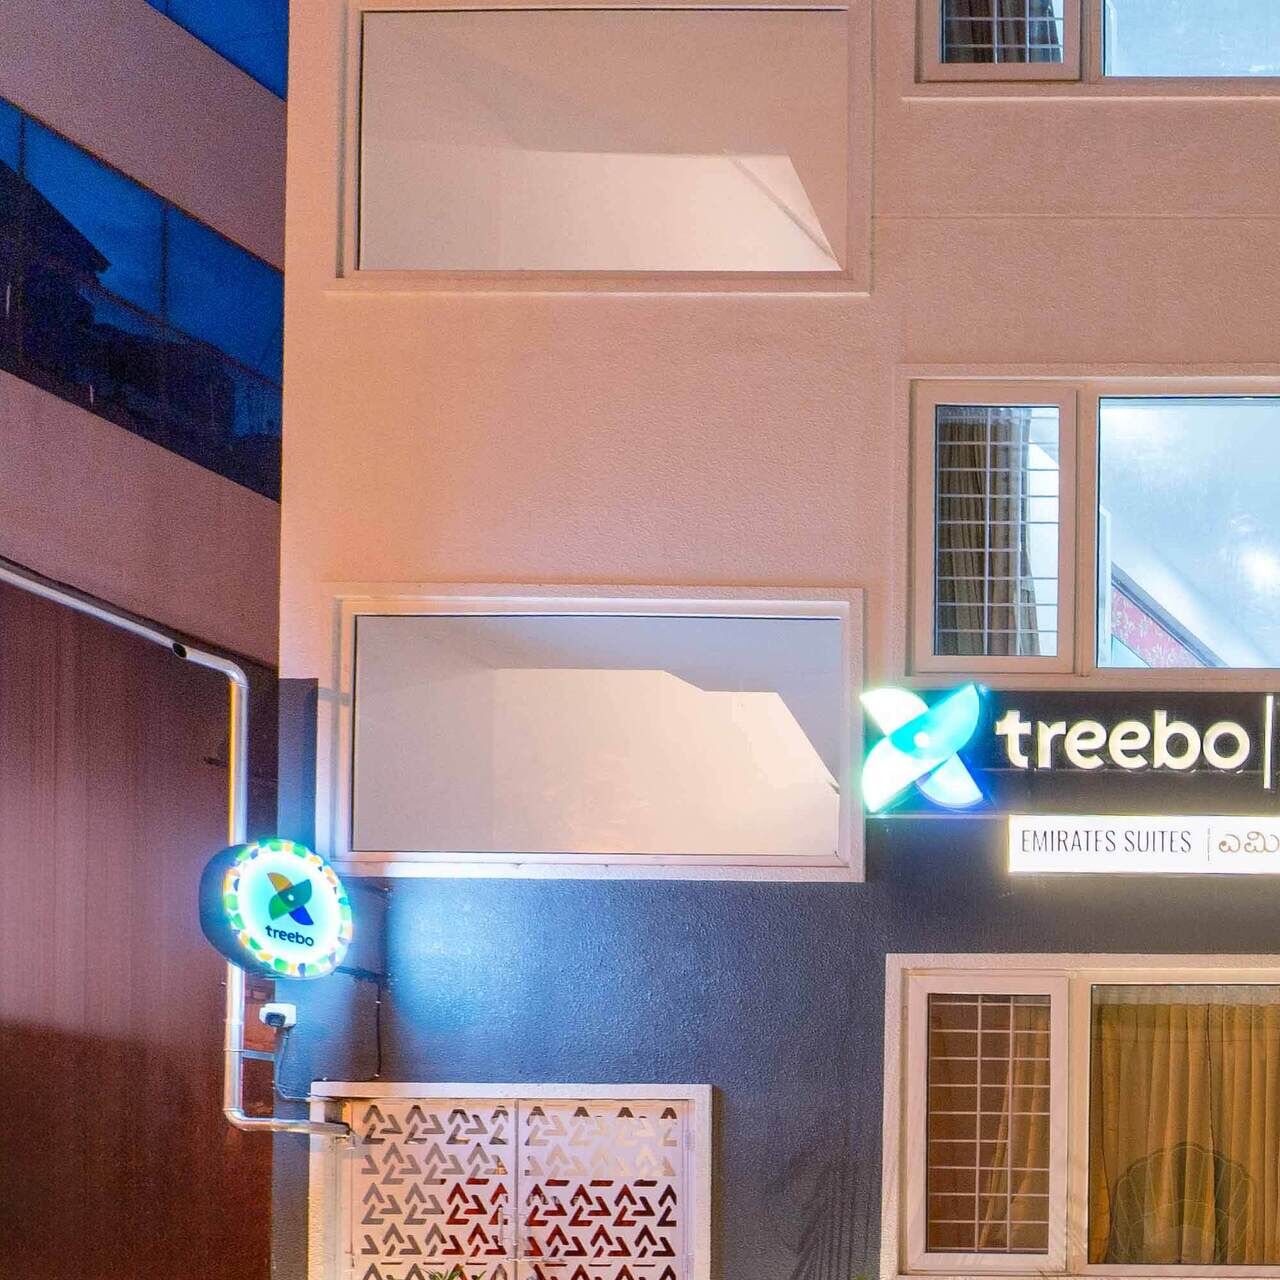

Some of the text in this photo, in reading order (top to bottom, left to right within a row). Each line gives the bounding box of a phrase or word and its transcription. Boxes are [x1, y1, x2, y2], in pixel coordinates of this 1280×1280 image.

[995, 710, 1250, 769] treebo
[1021, 829, 1192, 854] EMIRATES SUITES
[265, 925, 315, 947] treebo
